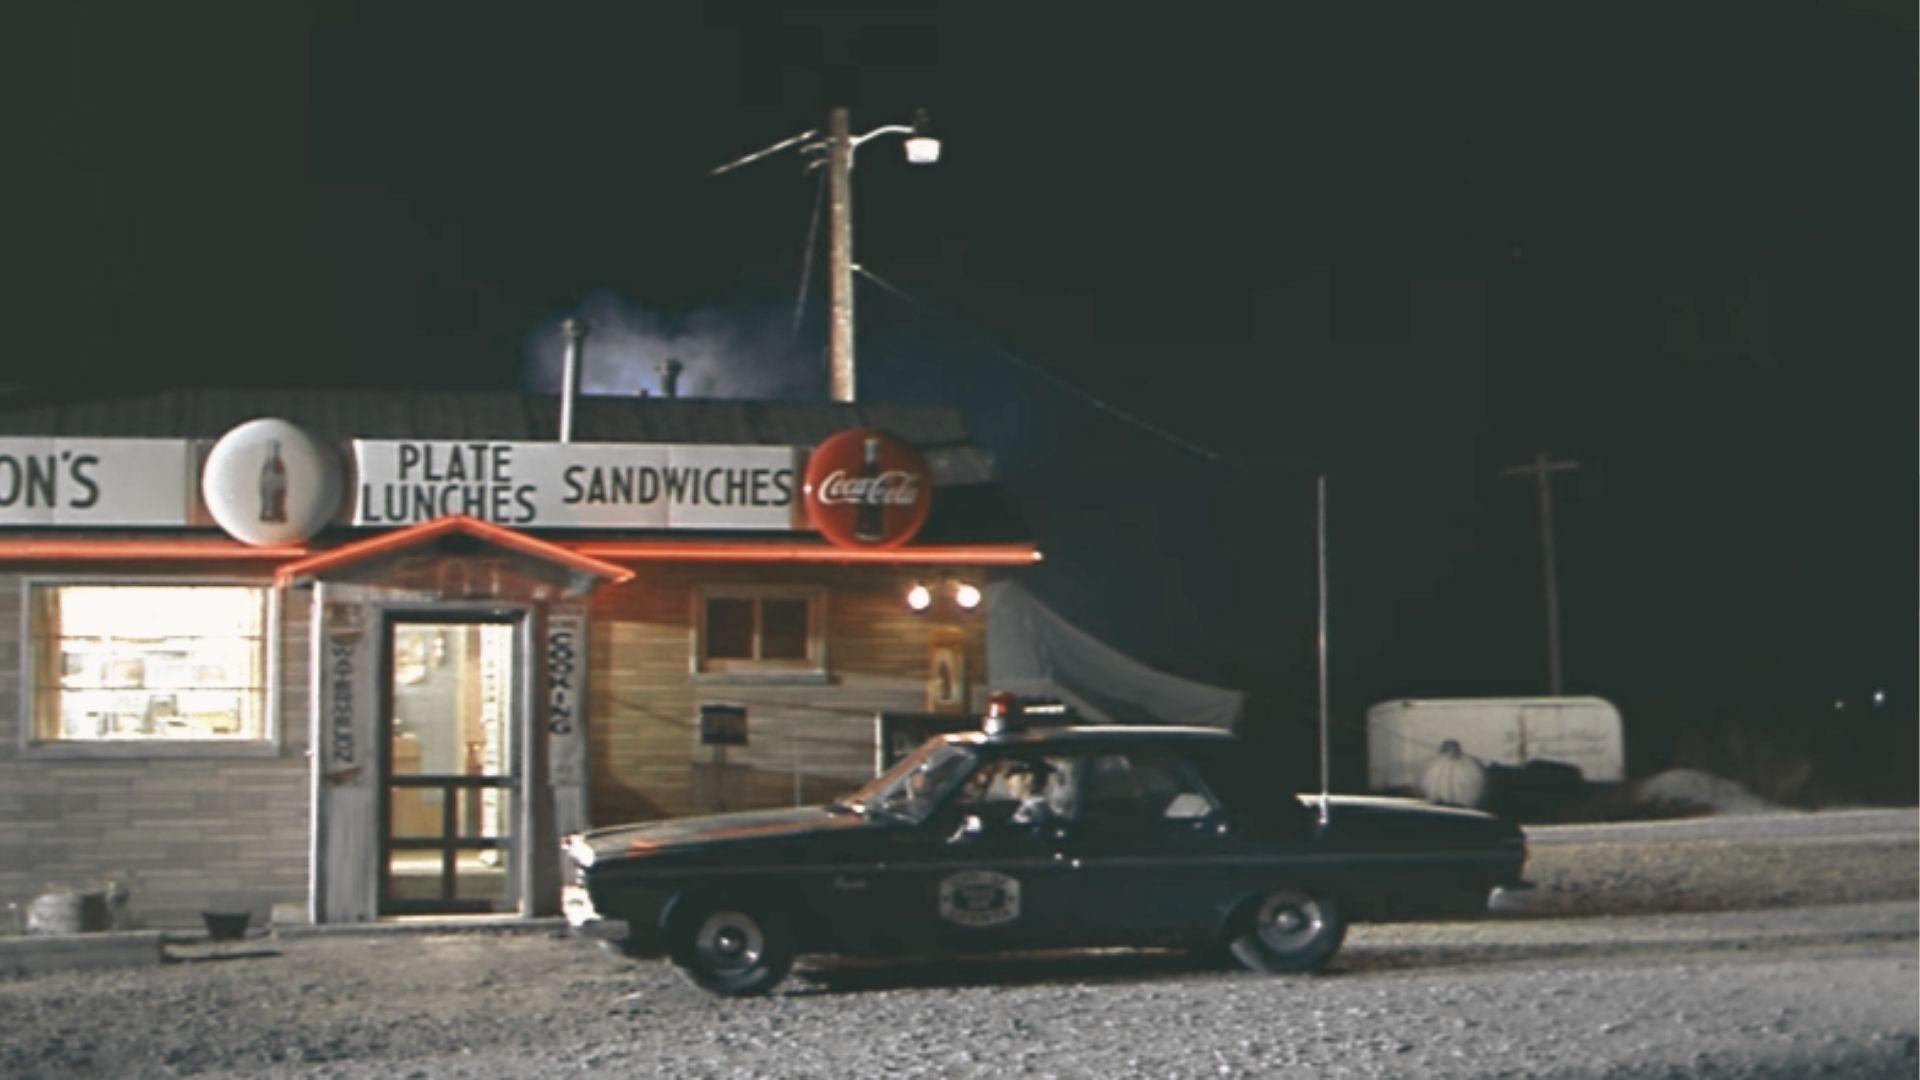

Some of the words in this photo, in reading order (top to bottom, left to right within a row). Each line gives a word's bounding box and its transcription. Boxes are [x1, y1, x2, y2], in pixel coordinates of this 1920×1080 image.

[398, 443, 512, 482] PLATE
[362, 484, 537, 523] LUNCHES
[563, 466, 793, 507] SANDWICHES
[818, 470, 918, 505] Coca-Cola
[548, 632, 574, 735] COOKING
